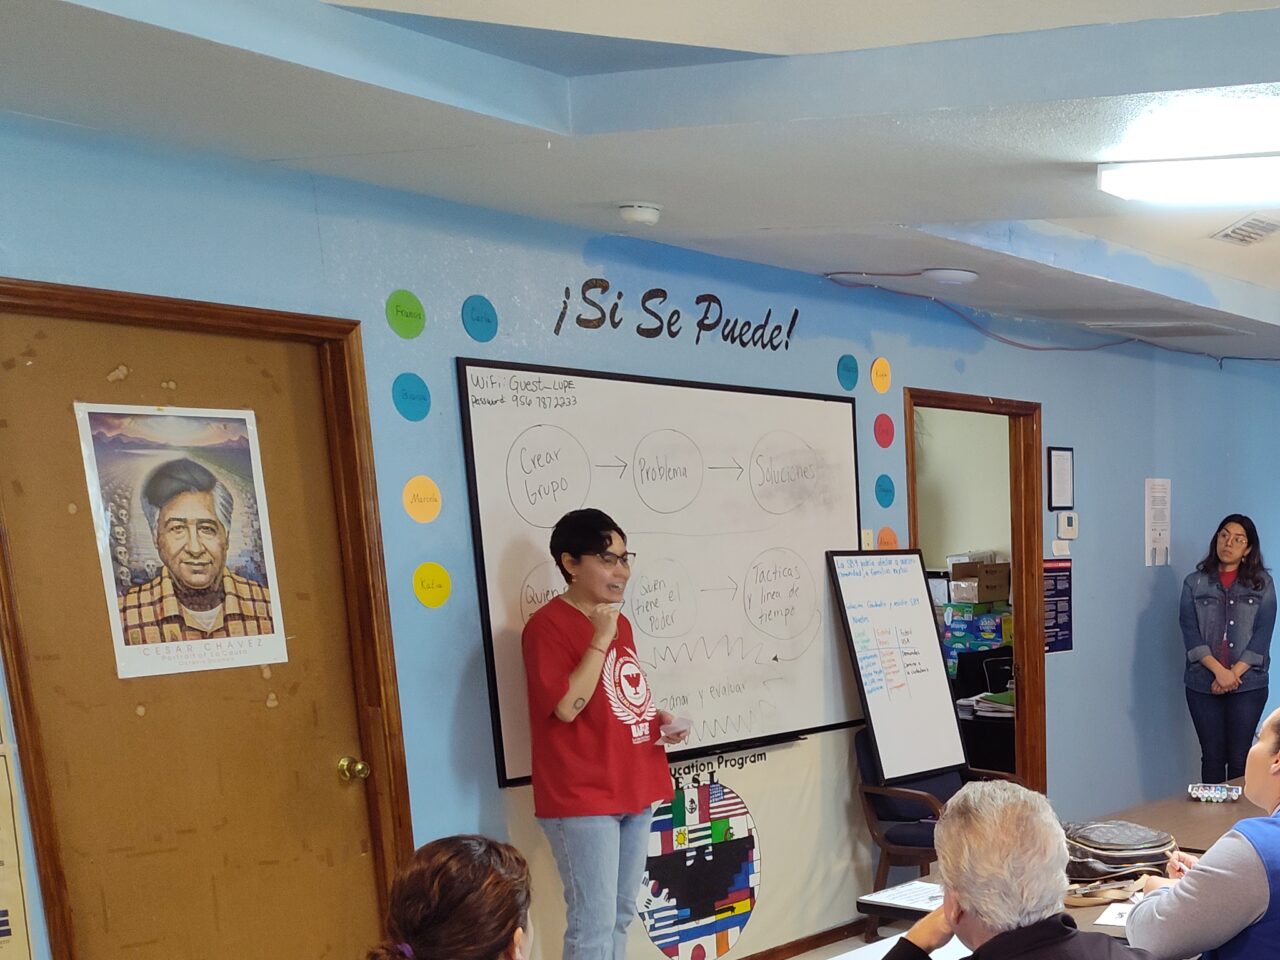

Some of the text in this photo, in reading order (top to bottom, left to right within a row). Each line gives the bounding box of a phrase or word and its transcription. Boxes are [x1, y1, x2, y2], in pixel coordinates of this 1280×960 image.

[636, 288, 682, 338] Se
[695, 293, 799, 351] Puede!
[520, 447, 561, 475] Crear
[638, 456, 688, 485] Problema
[756, 454, 816, 487] Soluciones
[525, 477, 568, 506] Grupo
[142, 639, 263, 657] CESAR CHAVEZ
[670, 752, 767, 777] ucation Program
